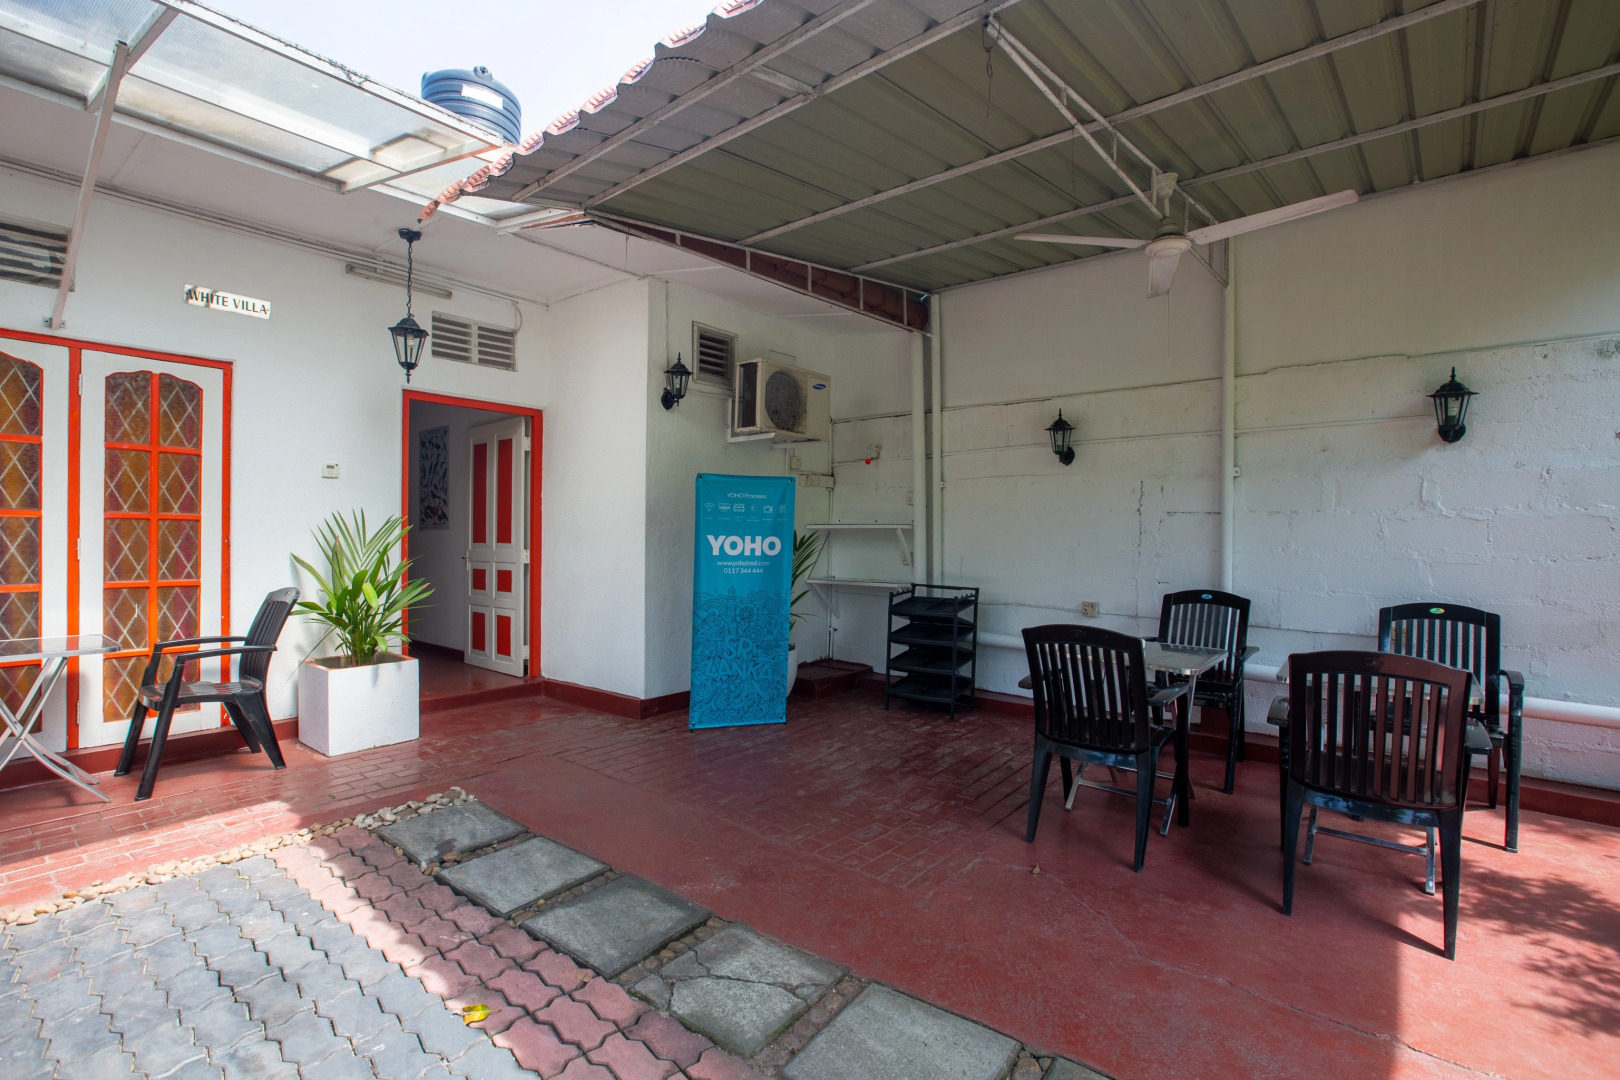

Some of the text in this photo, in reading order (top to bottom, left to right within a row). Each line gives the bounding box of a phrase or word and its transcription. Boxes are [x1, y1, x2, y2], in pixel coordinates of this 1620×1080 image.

[186, 288, 268, 315] WHITE VILLA
[744, 492, 767, 500] Promises
[706, 534, 782, 556] YOHO
[722, 634, 757, 661] SRI
[704, 658, 772, 681] LANKA
